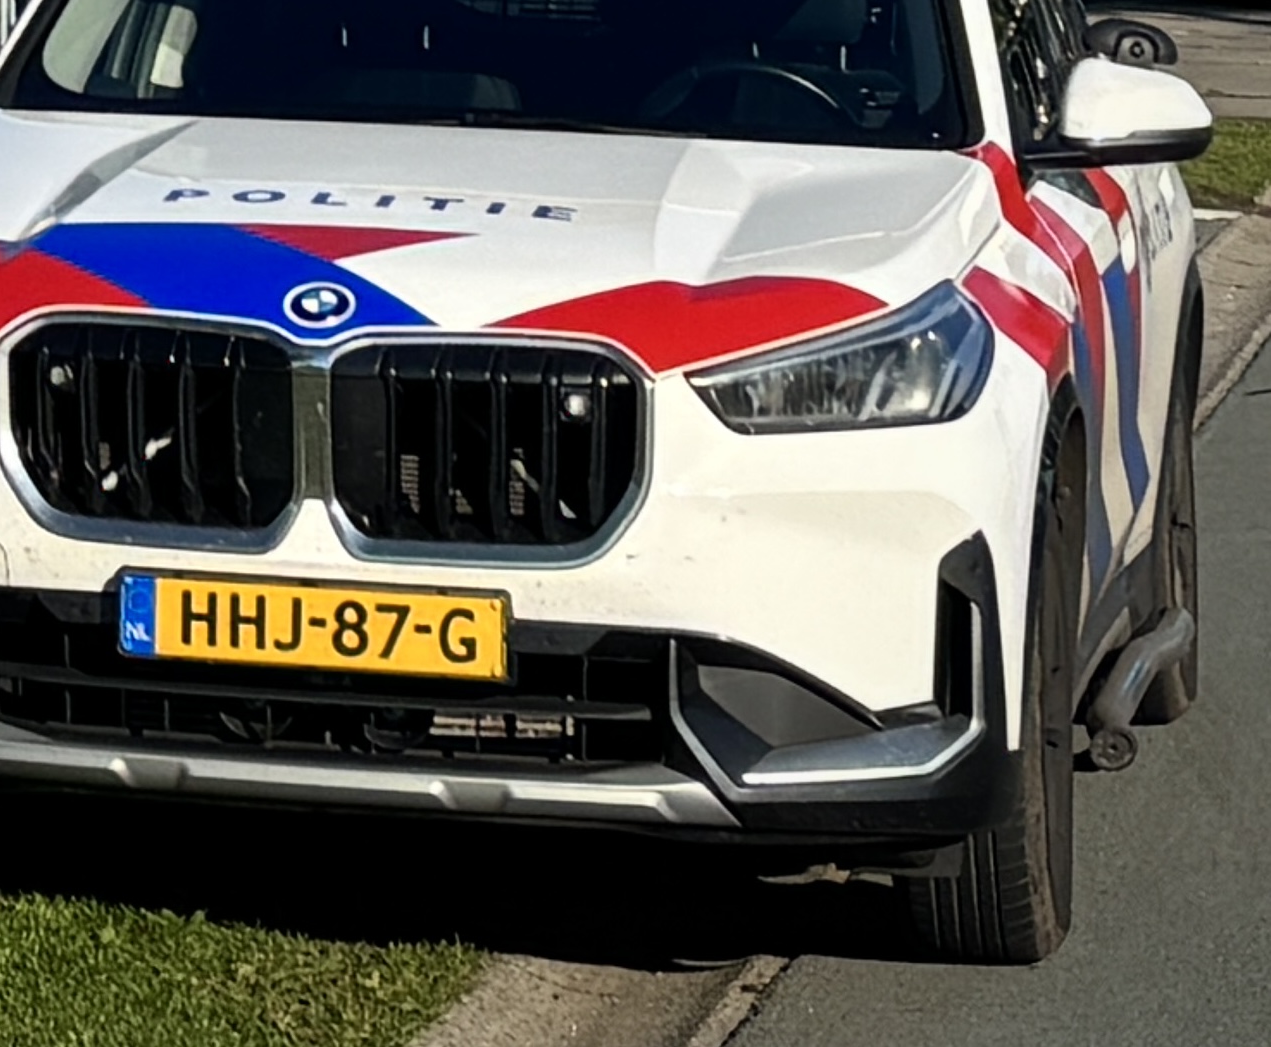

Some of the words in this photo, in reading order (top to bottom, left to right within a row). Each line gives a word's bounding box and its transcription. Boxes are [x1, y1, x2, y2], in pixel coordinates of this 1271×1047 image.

[163, 188, 578, 222] POLITIE
[125, 619, 152, 642] NL
[180, 589, 478, 663] HHJ-87-G
